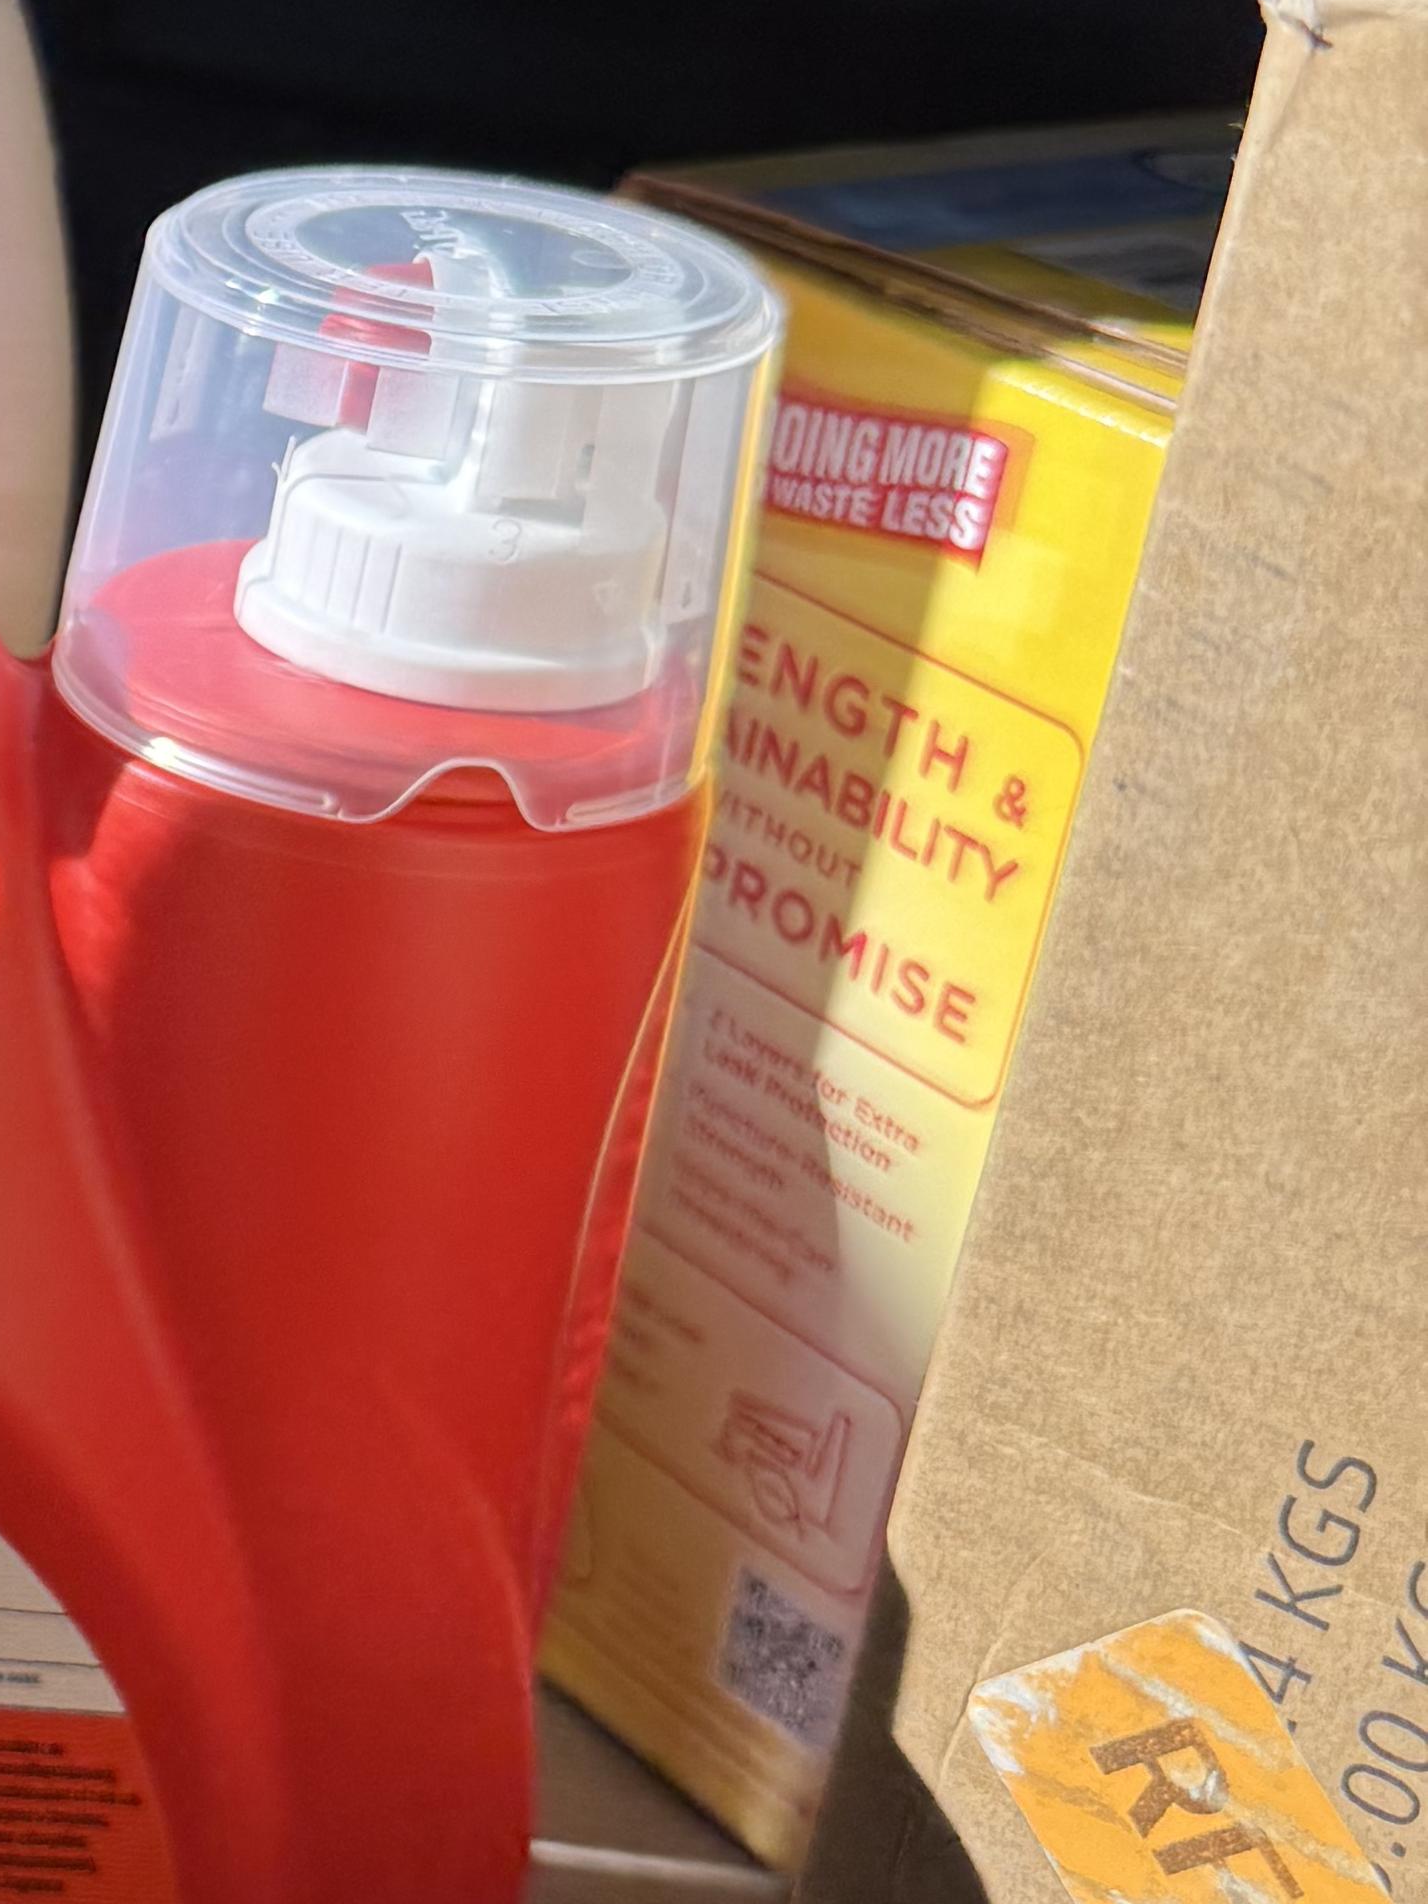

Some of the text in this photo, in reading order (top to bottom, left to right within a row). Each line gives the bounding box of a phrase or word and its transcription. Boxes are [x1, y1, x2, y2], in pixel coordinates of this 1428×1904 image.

[768, 399, 1007, 500] OING MORE
[770, 476, 987, 551] WASTE LESS
[994, 775, 1030, 829] &
[855, 1097, 921, 1153] Extra
[1254, 1439, 1378, 1632] KGS
